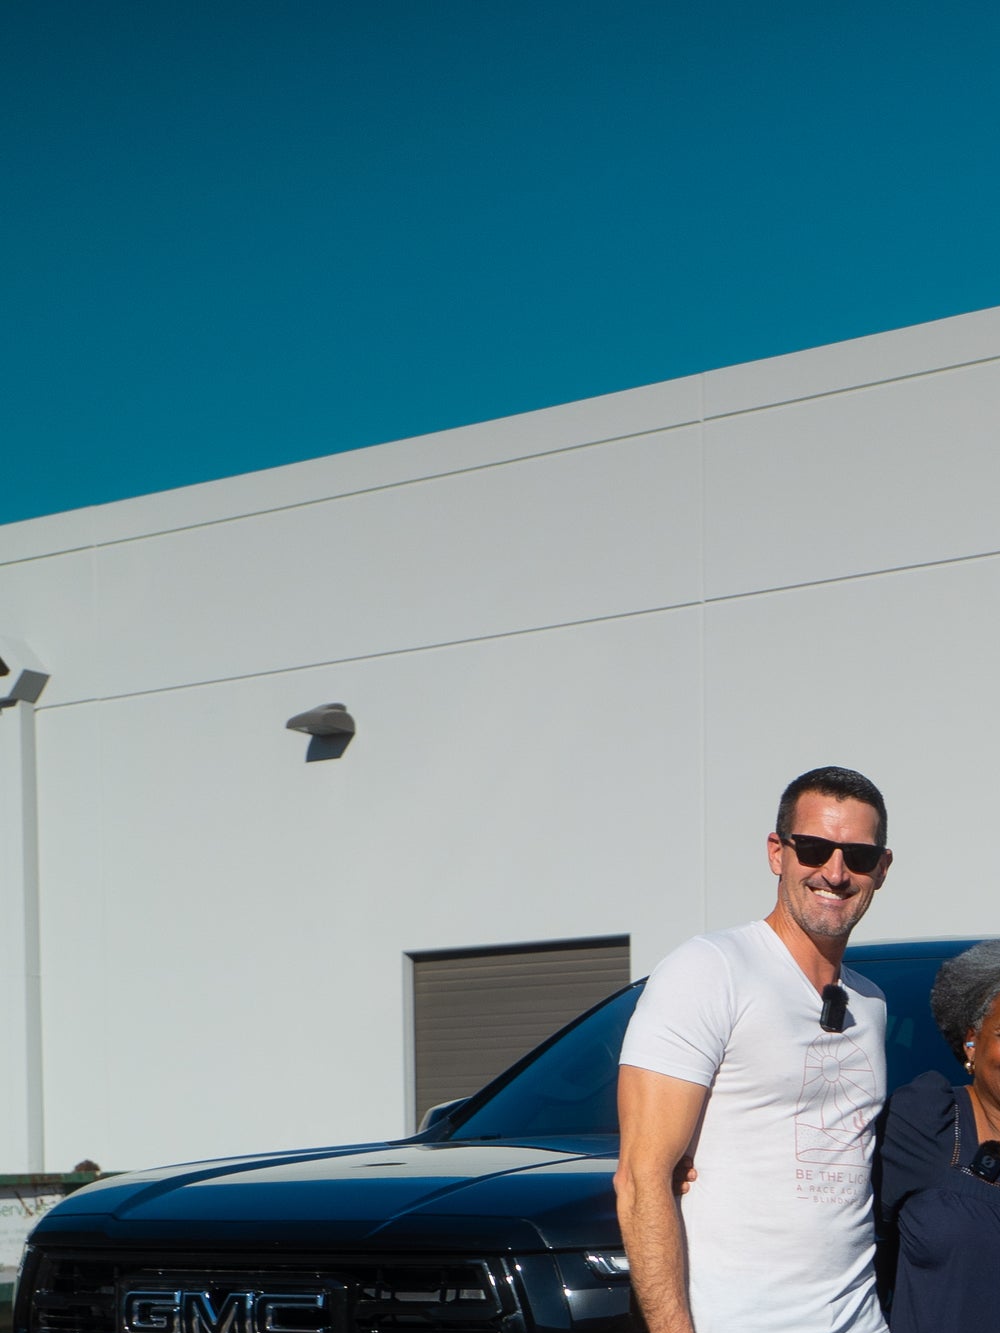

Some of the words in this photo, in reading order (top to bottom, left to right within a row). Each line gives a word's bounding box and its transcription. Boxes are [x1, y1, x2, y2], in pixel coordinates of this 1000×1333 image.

[796, 1169, 813, 1180] BE
[819, 1171, 844, 1183] THE
[796, 1184, 803, 1192] A
[809, 1185, 836, 1194] RACE
